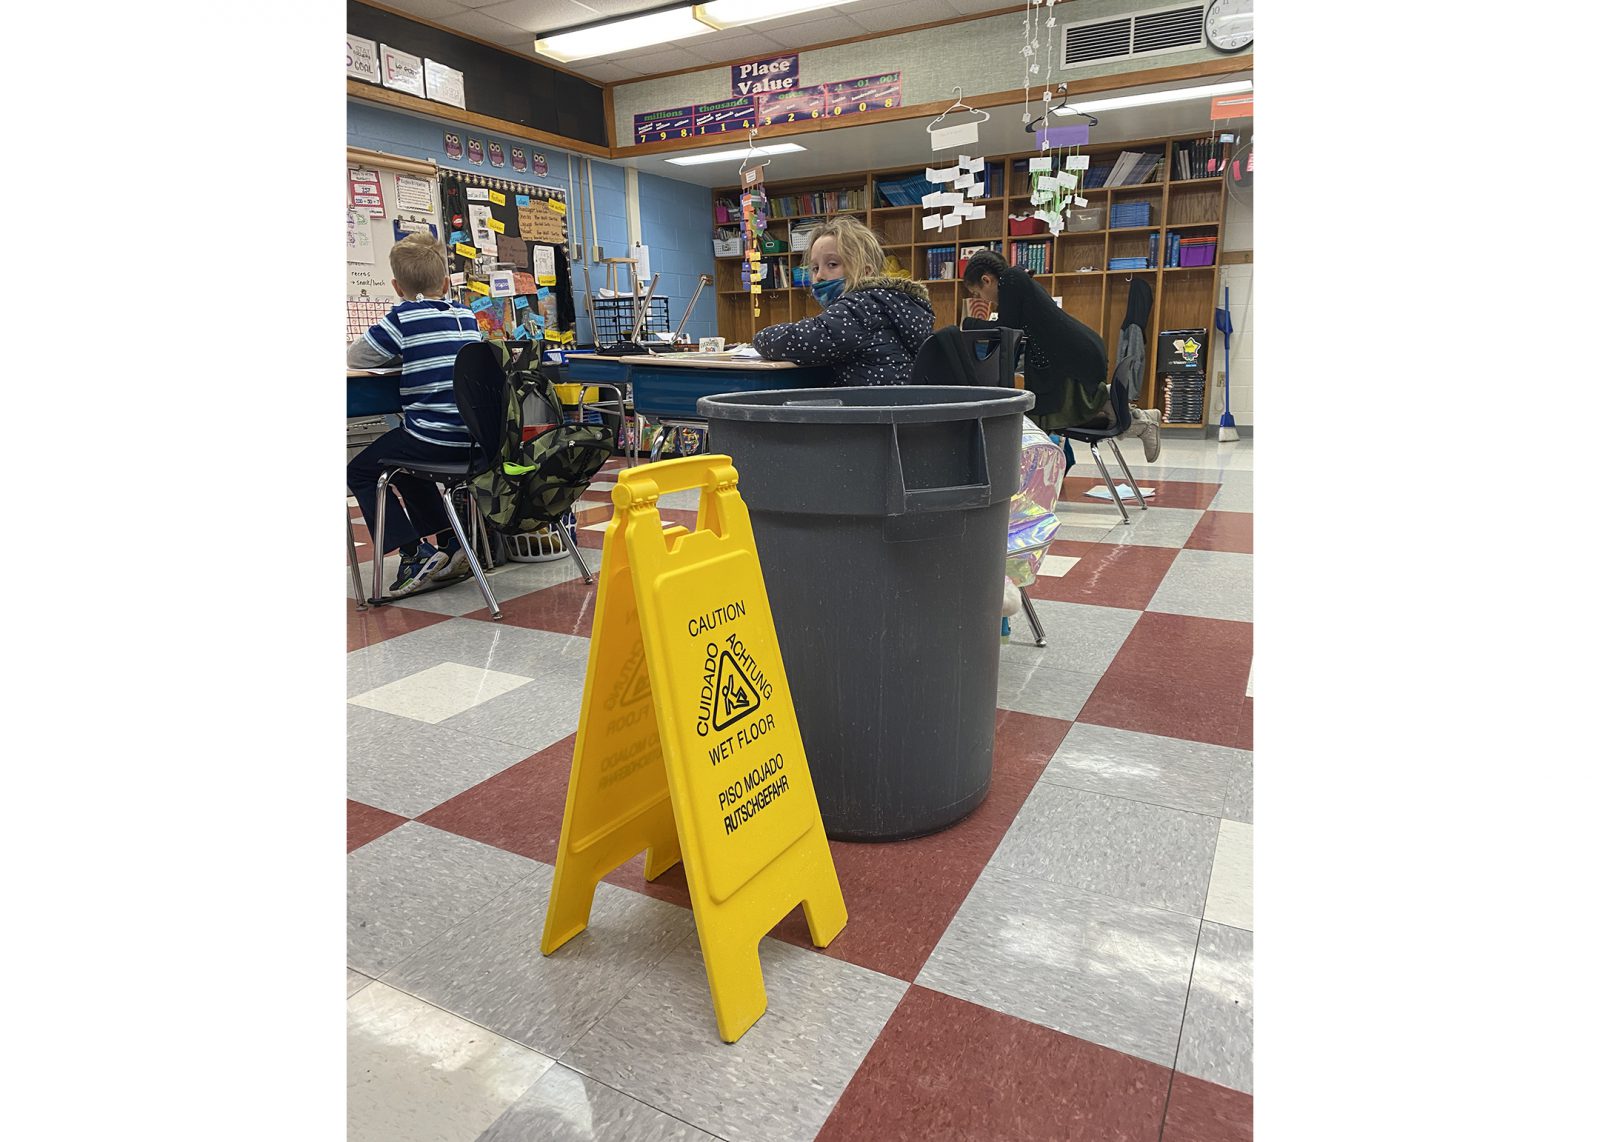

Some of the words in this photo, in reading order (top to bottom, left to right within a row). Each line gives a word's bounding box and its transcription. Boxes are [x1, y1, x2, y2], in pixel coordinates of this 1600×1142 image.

[1212, 6, 1220, 15] 10
[1212, 29, 1217, 38] 8
[1231, 38, 1237, 47] 6
[740, 60, 790, 79] Place
[877, 73, 899, 85] .001
[738, 78, 793, 95] Value
[699, 98, 748, 113] thousands
[640, 134, 646, 143] 7
[660, 131, 667, 140] 9
[701, 126, 705, 135] 1
[721, 122, 726, 132] 1
[764, 116, 772, 126] 3
[787, 112, 795, 122] 2
[833, 106, 842, 116] 0
[859, 102, 867, 112] 0
[884, 98, 893, 108] 8
[644, 111, 683, 121] millions
[688, 600, 746, 637] CAUTION
[726, 633, 773, 700] ACHTUNG
[696, 643, 718, 737] CUIDADO
[708, 737, 734, 766] WET
[737, 713, 775, 749] FLOOR
[719, 781, 743, 811] PISO
[743, 753, 784, 793] MOJADO
[723, 775, 789, 835] RUTSCHGEFAHR
